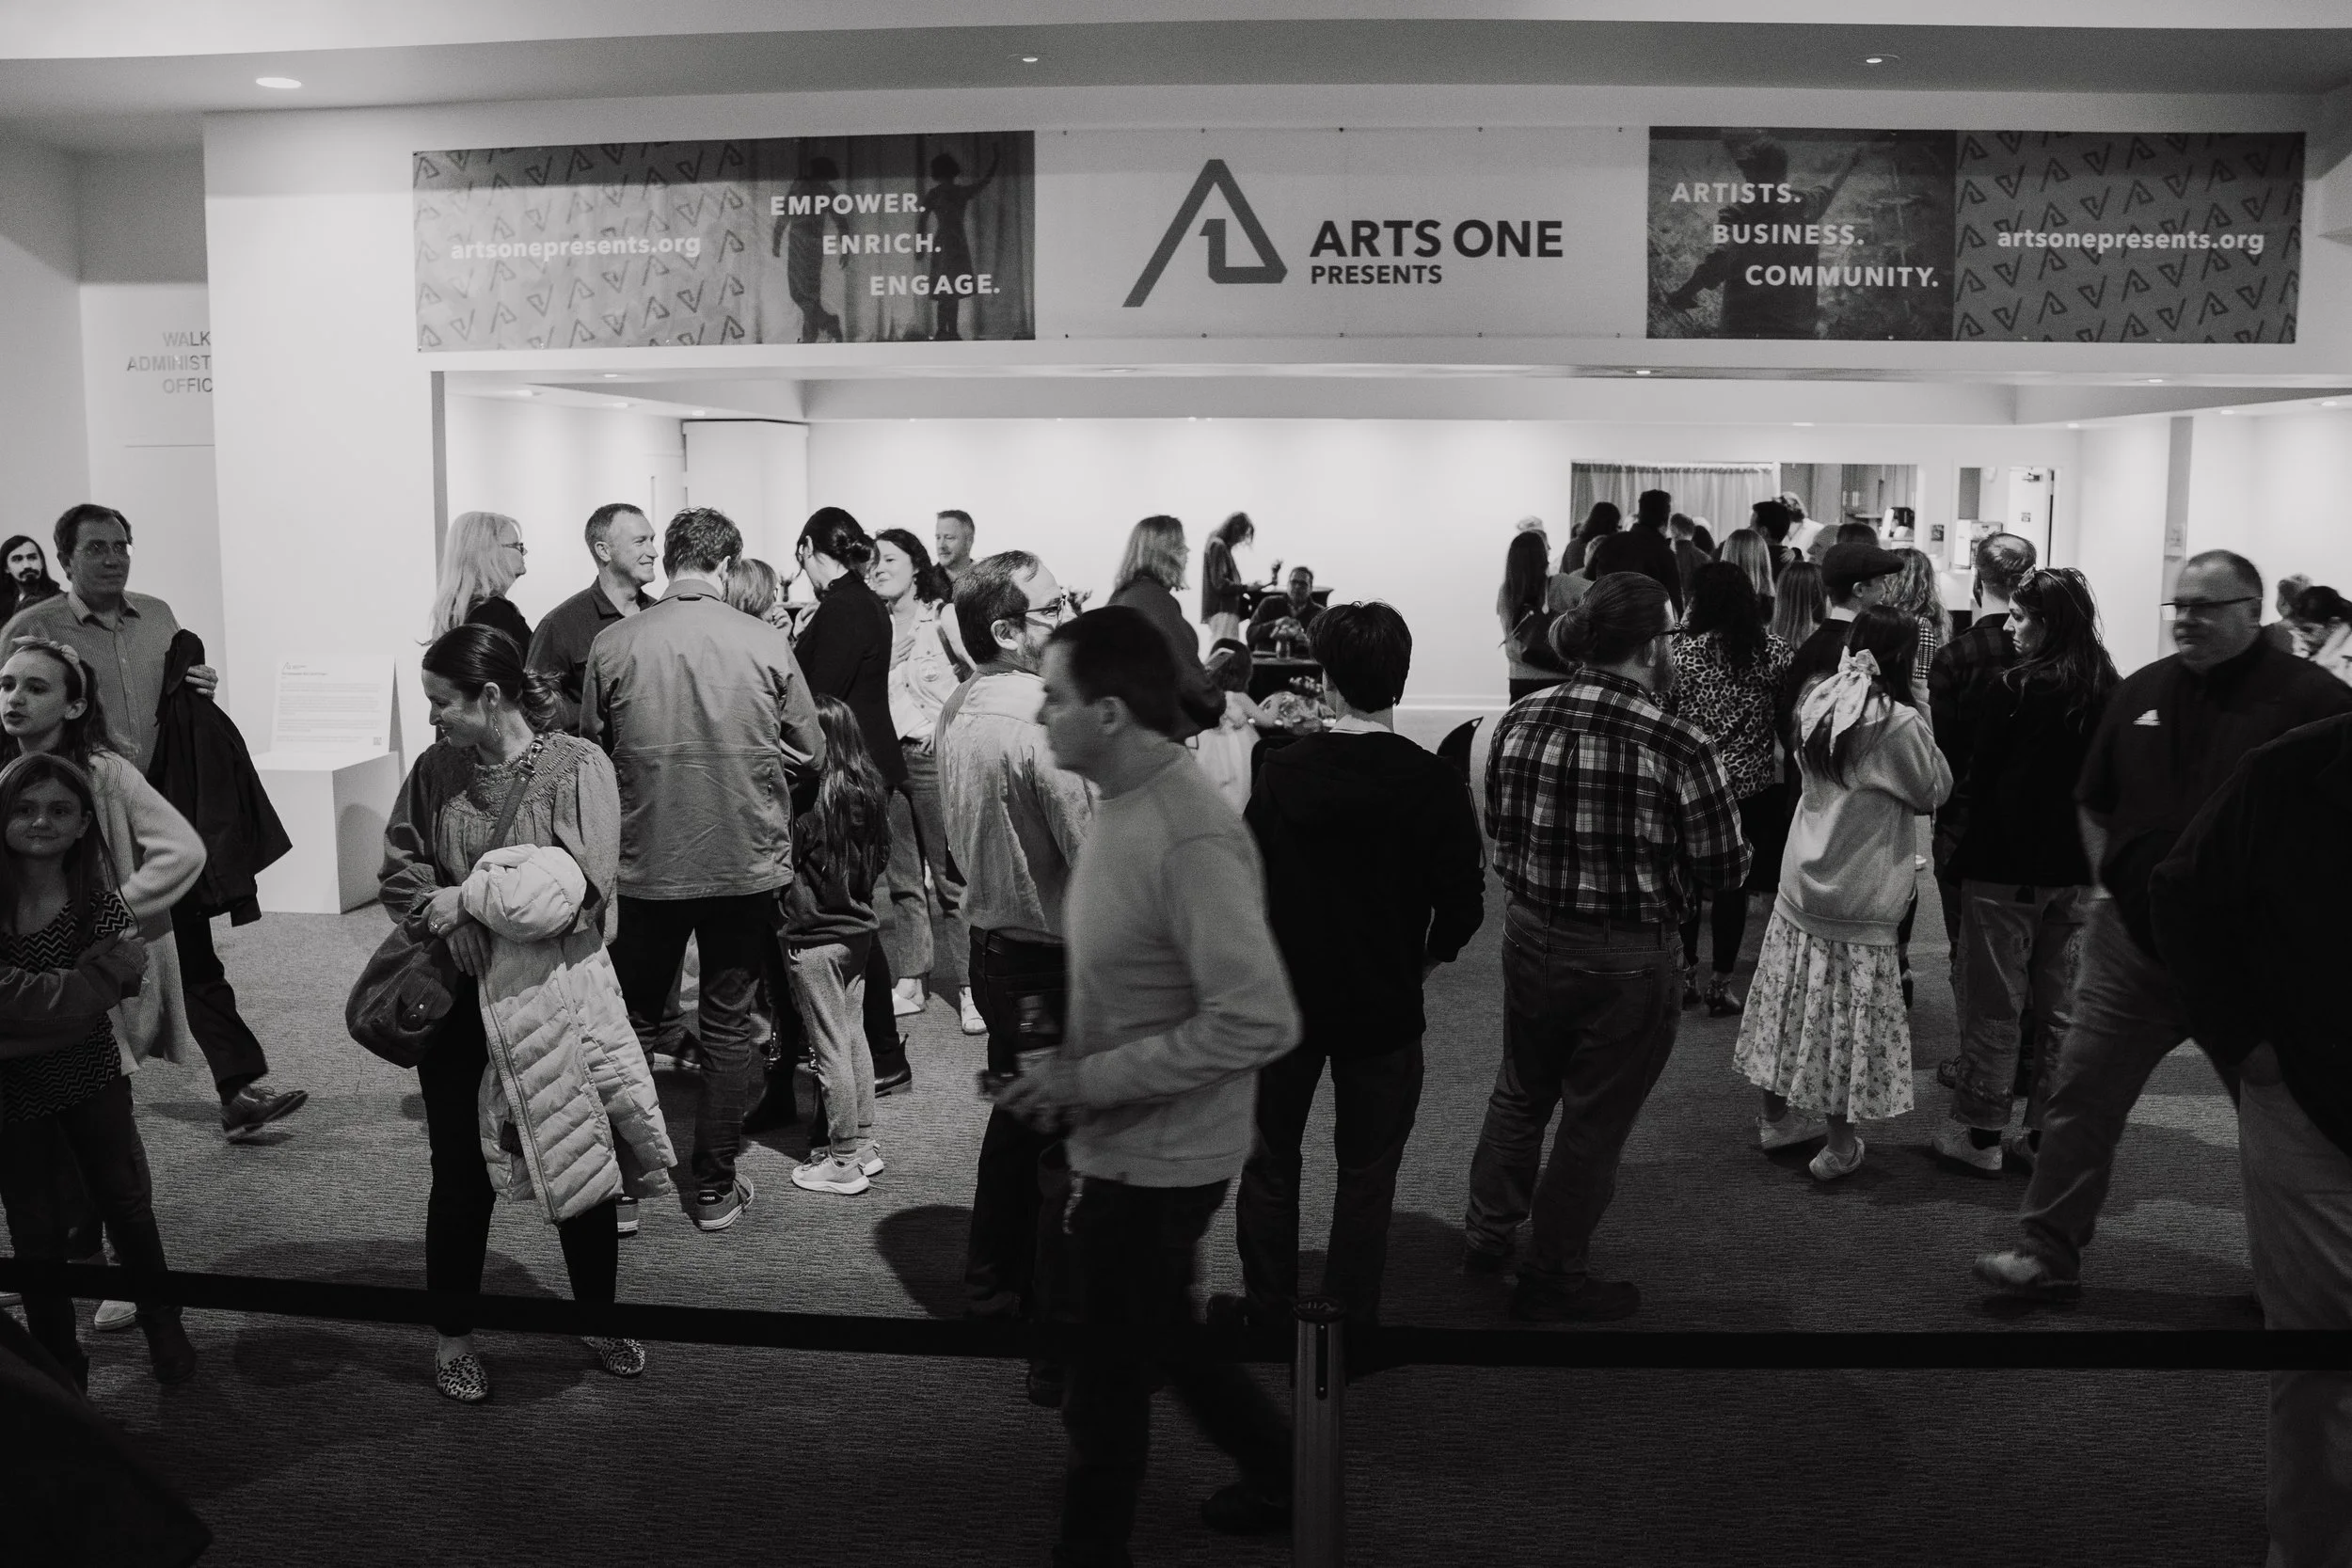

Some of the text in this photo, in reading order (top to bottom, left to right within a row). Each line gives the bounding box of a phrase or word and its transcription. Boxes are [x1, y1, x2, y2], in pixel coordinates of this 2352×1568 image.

[1670, 182, 1802, 203] ARTISTS.
[771, 193, 926, 217] EMPOWER.
[822, 232, 942, 255] ENRICH.
[1310, 219, 1563, 258] ARTS ONE
[1712, 223, 1865, 245] BUSINESS.
[1996, 229, 2265, 255] artsonepresents.org
[452, 235, 702, 261] artsonepresents.org
[869, 274, 1001, 296] ENGAGE.
[1311, 265, 1442, 285] PRESENTS
[1744, 264, 1939, 288] COMMUNITY.
